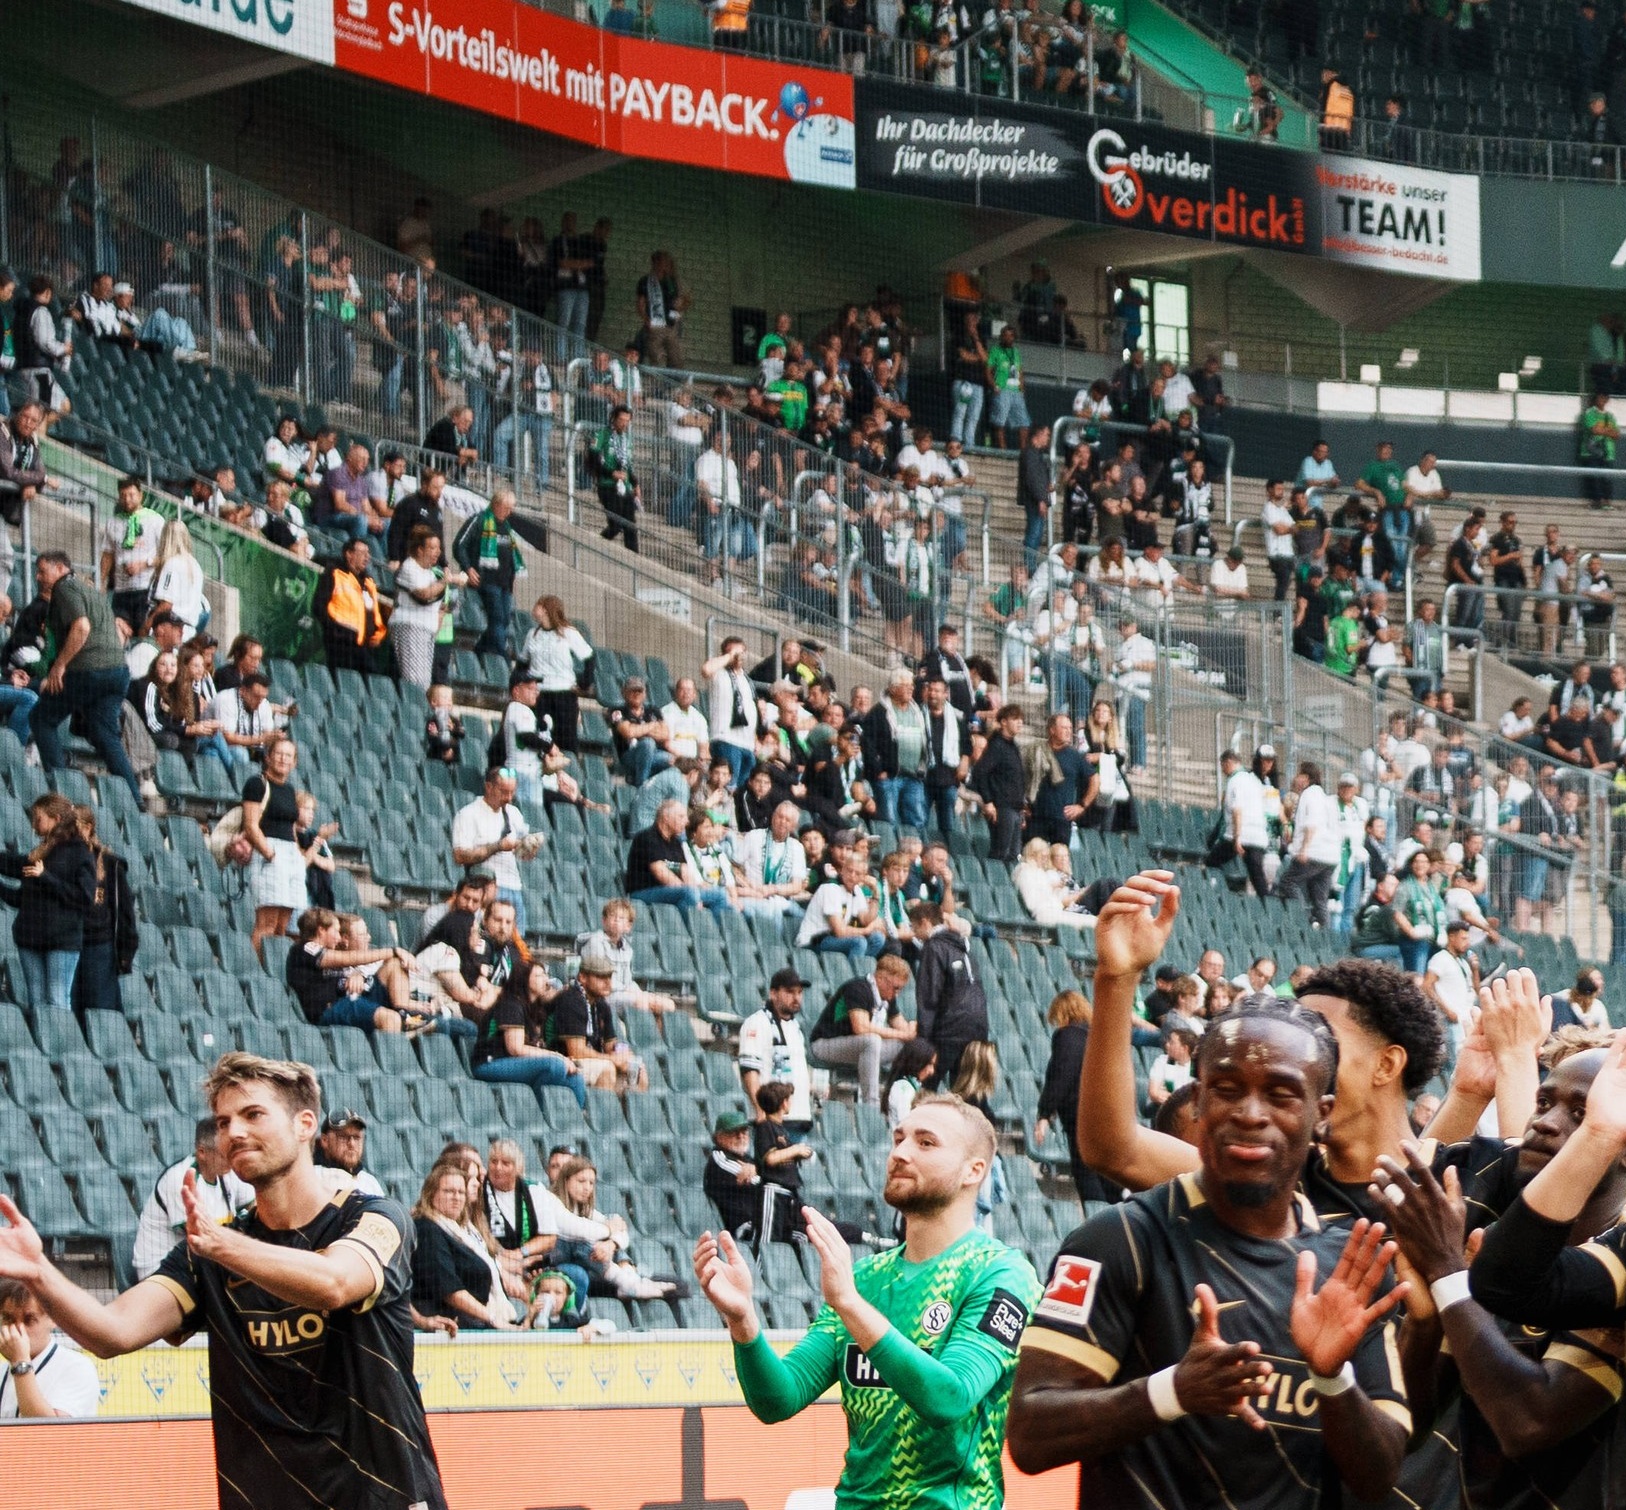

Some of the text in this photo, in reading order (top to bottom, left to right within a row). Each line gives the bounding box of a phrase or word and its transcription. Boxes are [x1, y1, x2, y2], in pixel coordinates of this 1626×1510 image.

[388, 2, 561, 96] S-Vorteilswelt
[566, 61, 605, 109] mit
[609, 71, 780, 141] PAYBACK.
[876, 114, 1026, 144] Ihr Dachdecker
[891, 144, 928, 177] für
[929, 147, 1060, 180] Großprojekte
[1087, 128, 1212, 184] Gebrüder
[1103, 164, 1290, 242] Overdick
[1314, 164, 1448, 203] Verstärke unser
[1337, 194, 1446, 247] TEAM!
[247, 1312, 324, 1347] HYLO
